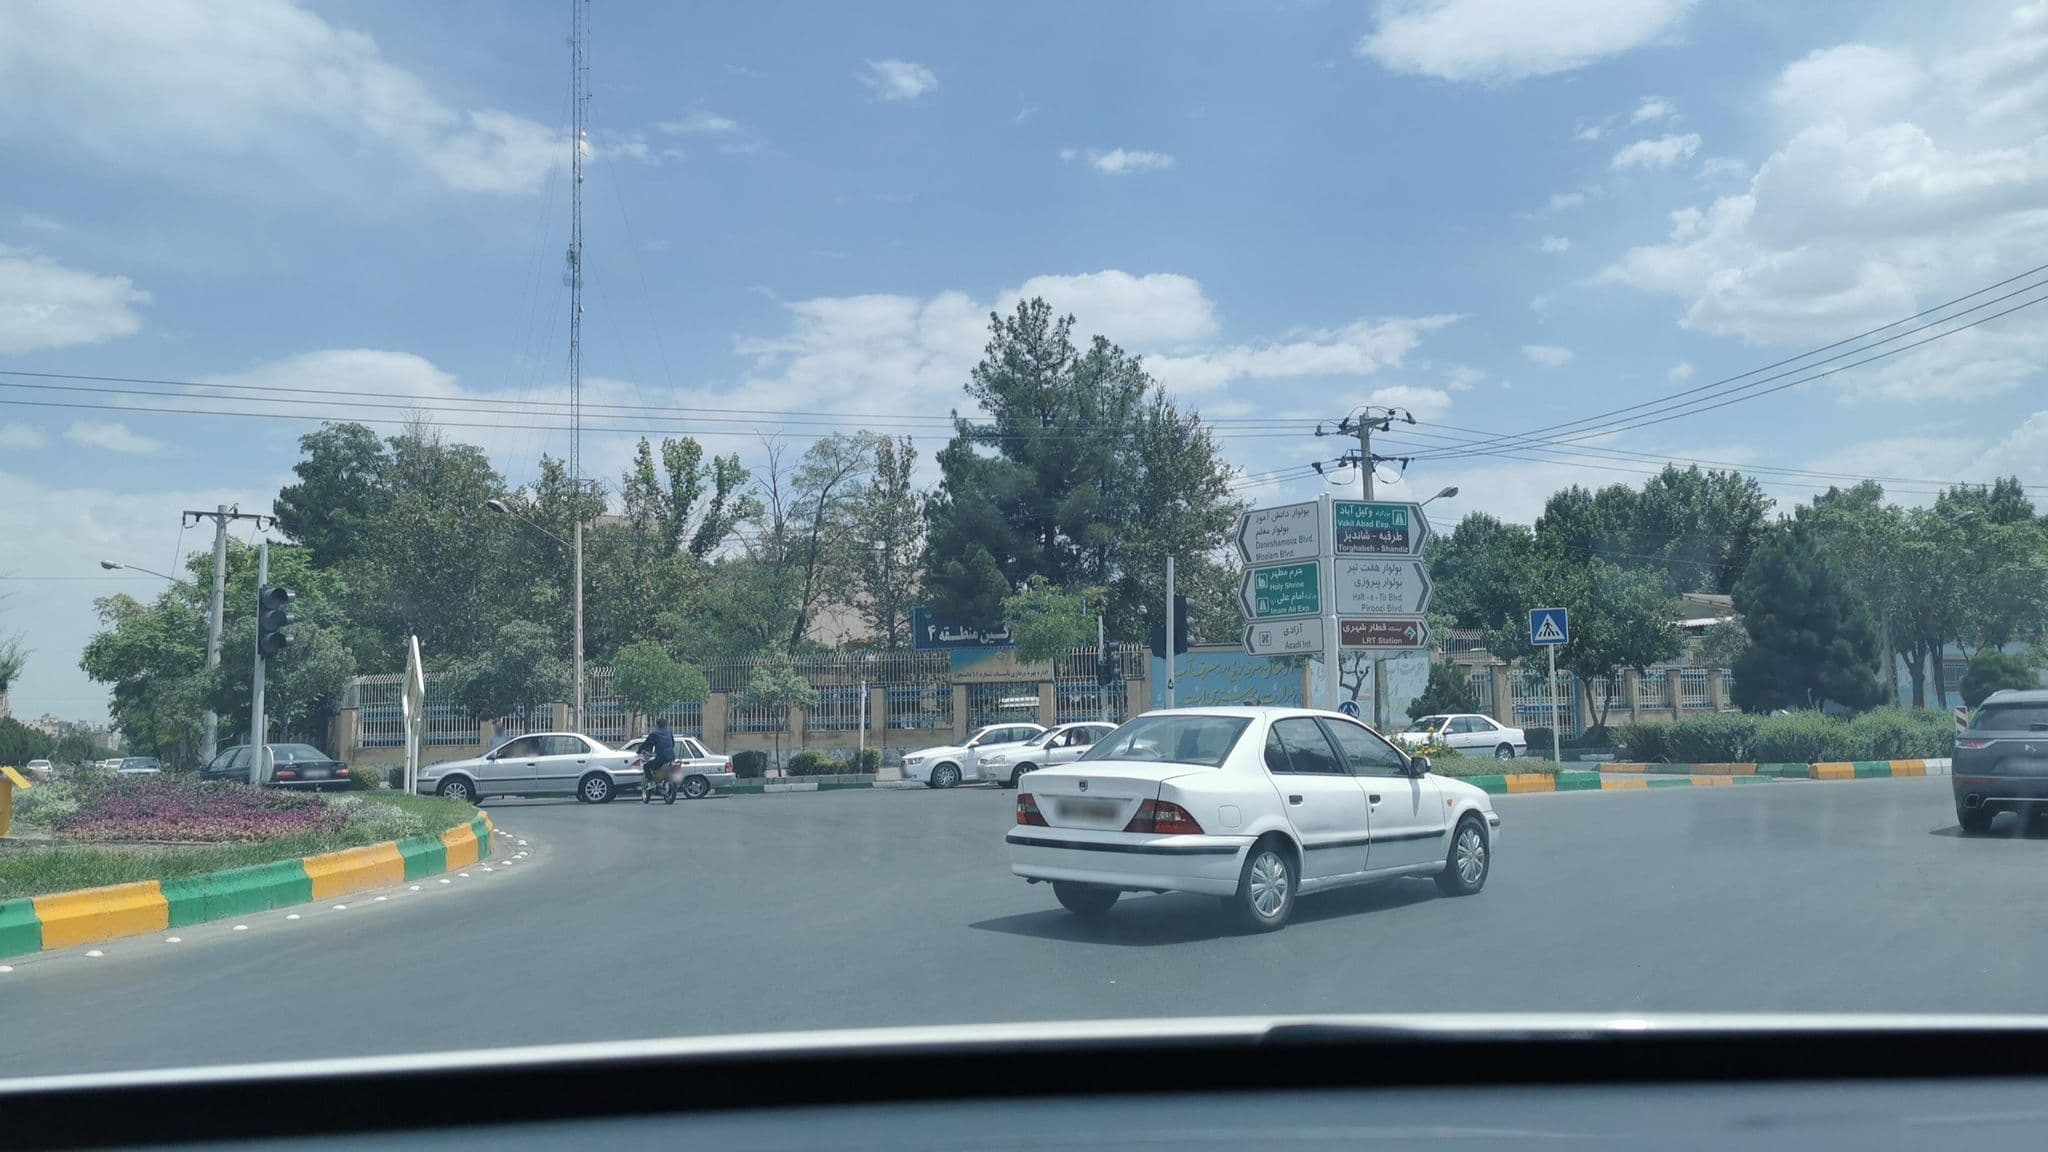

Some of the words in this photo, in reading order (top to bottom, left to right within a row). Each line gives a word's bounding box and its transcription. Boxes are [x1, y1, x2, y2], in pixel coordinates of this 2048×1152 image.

[1271, 508, 1289, 522] دانش
[1292, 507, 1310, 519] بولوار
[1340, 505, 1354, 516] آباد
[1355, 507, 1373, 518] وکیل
[1338, 519, 1355, 527] Vakil
[1356, 520, 1374, 528] Abad
[1255, 527, 1270, 540] معلم
[1272, 524, 1289, 536] بولوار
[1344, 530, 1371, 542] شاندیز
[1379, 531, 1403, 543] طرقبه
[1338, 544, 1375, 552] Torghabeh
[1381, 545, 1408, 553] Shandiz
[1289, 567, 1303, 577] حرم
[1348, 564, 1359, 574] تیر
[1361, 563, 1380, 571] هفت
[1382, 563, 1402, 575] بولوار
[1271, 569, 1288, 580] مطهر
[1270, 583, 1284, 591] Holy
[1354, 579, 1381, 589] پیروزی
[1382, 577, 1402, 589] بولوار
[1277, 593, 1290, 604] علی
[1291, 591, 1304, 605] امام
[1362, 603, 1384, 611] Piroozi
[928, 624, 936, 641] ۴
[939, 625, 979, 641] منطقه
[1283, 623, 1303, 636] آزادی
[1343, 623, 1367, 633] شهری
[1369, 623, 1387, 632] قطار
[1362, 637, 1376, 645] LRT
[1378, 637, 1402, 645] Station
